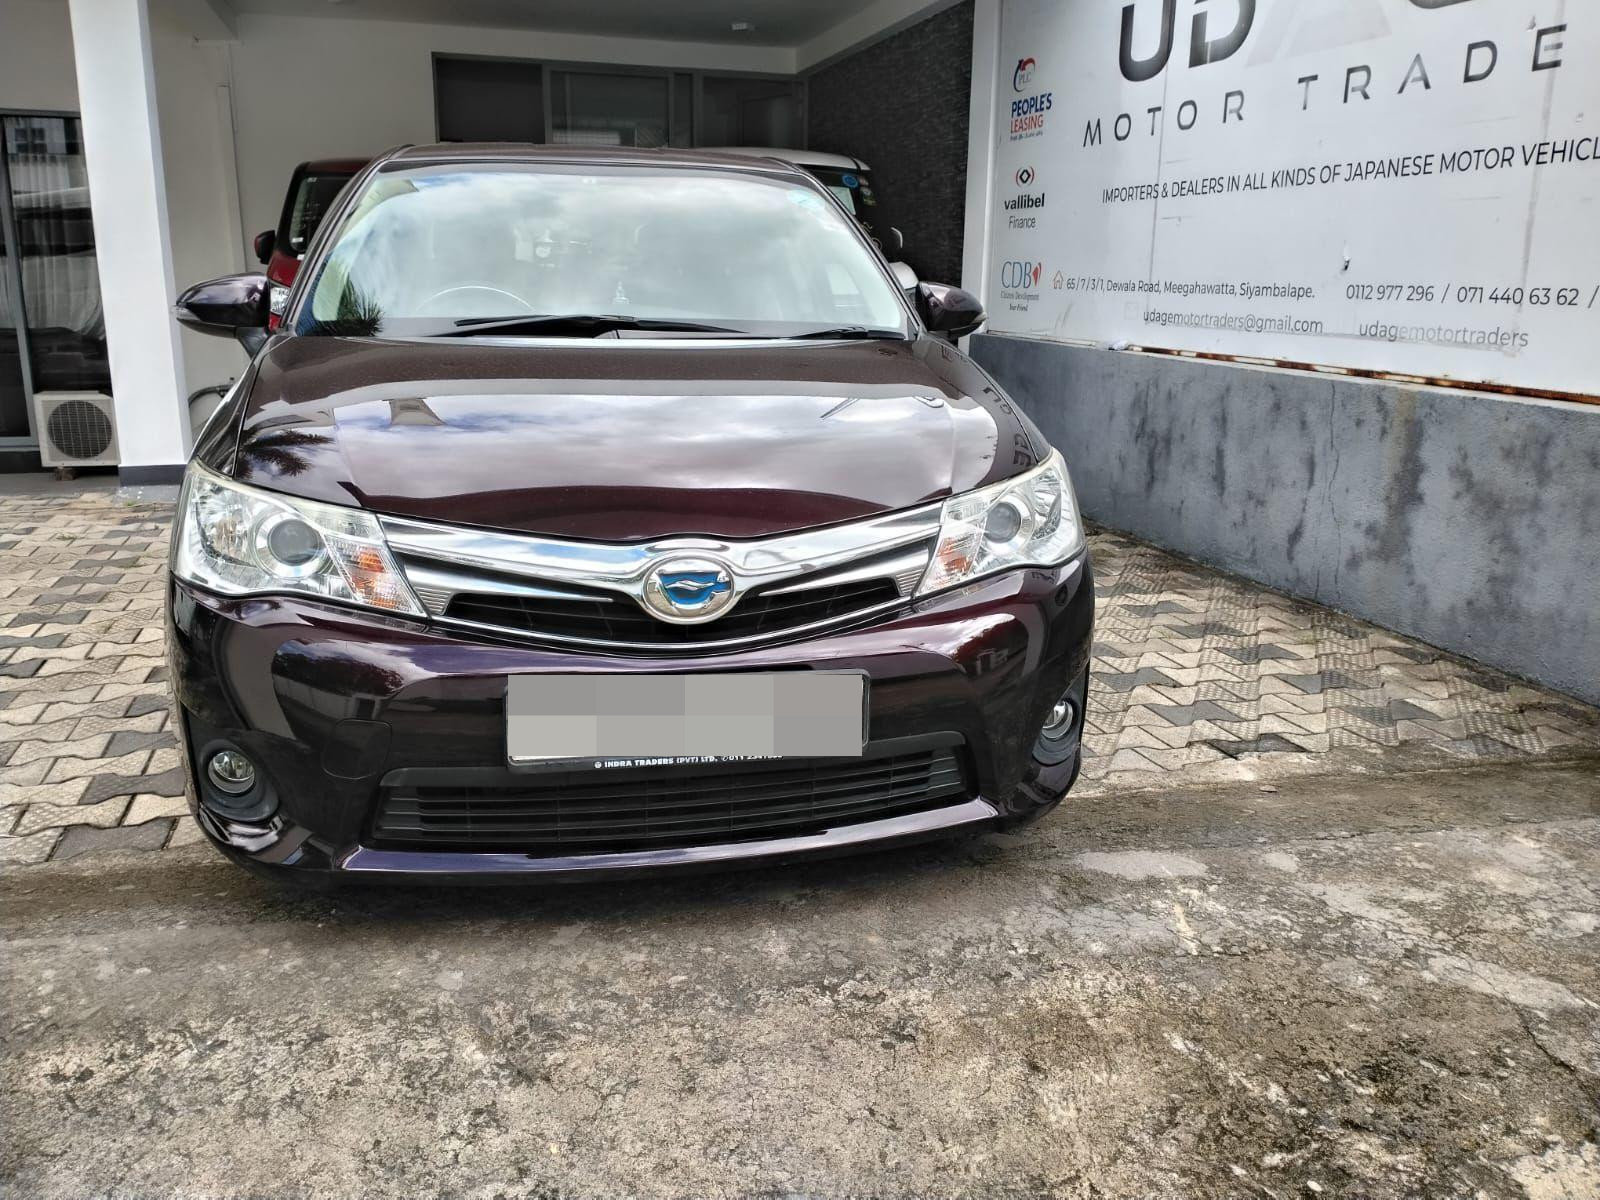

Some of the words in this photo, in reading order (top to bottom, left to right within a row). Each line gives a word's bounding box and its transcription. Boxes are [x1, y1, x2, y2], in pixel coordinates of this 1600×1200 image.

[1083, 89, 1246, 148] MOTOR
[1297, 24, 1568, 111] TRADE
[1011, 92, 1053, 118] PEOPLE'S
[1010, 114, 1044, 134] LEASING
[1102, 184, 1159, 203] IMPORTERS
[1161, 184, 1168, 198] &
[1171, 176, 1224, 198] DEALERS
[1227, 175, 1241, 193] IN
[1242, 172, 1267, 191] ALL
[1271, 166, 1316, 188] KINDS
[1319, 164, 1342, 184] OF
[1344, 154, 1434, 182] JAPANESE
[1439, 146, 1515, 173] MOTOR
[1521, 136, 1600, 166] VEHICL
[1004, 192, 1045, 210] vallibel
[1008, 215, 1036, 229] Finance
[1001, 261, 1032, 289] CDB
[1106, 279, 1136, 292] Dewala
[1138, 280, 1162, 294] Road,
[1163, 280, 1238, 297] Meegahawatta,
[1239, 282, 1315, 301] Siyambalape.
[1346, 284, 1373, 300] 0112
[1376, 285, 1403, 300] 977
[1406, 285, 1435, 301] 296
[1457, 286, 1484, 304] 071
[1488, 287, 1524, 305] 440
[1529, 287, 1551, 306] 63
[1556, 288, 1580, 306] 62
[1143, 309, 1324, 335] udagemotortraders@gmail.com
[1358, 320, 1529, 348] udagemotortraders
[604, 760, 632, 768] INDRA
[634, 757, 674, 766] TRADERS
